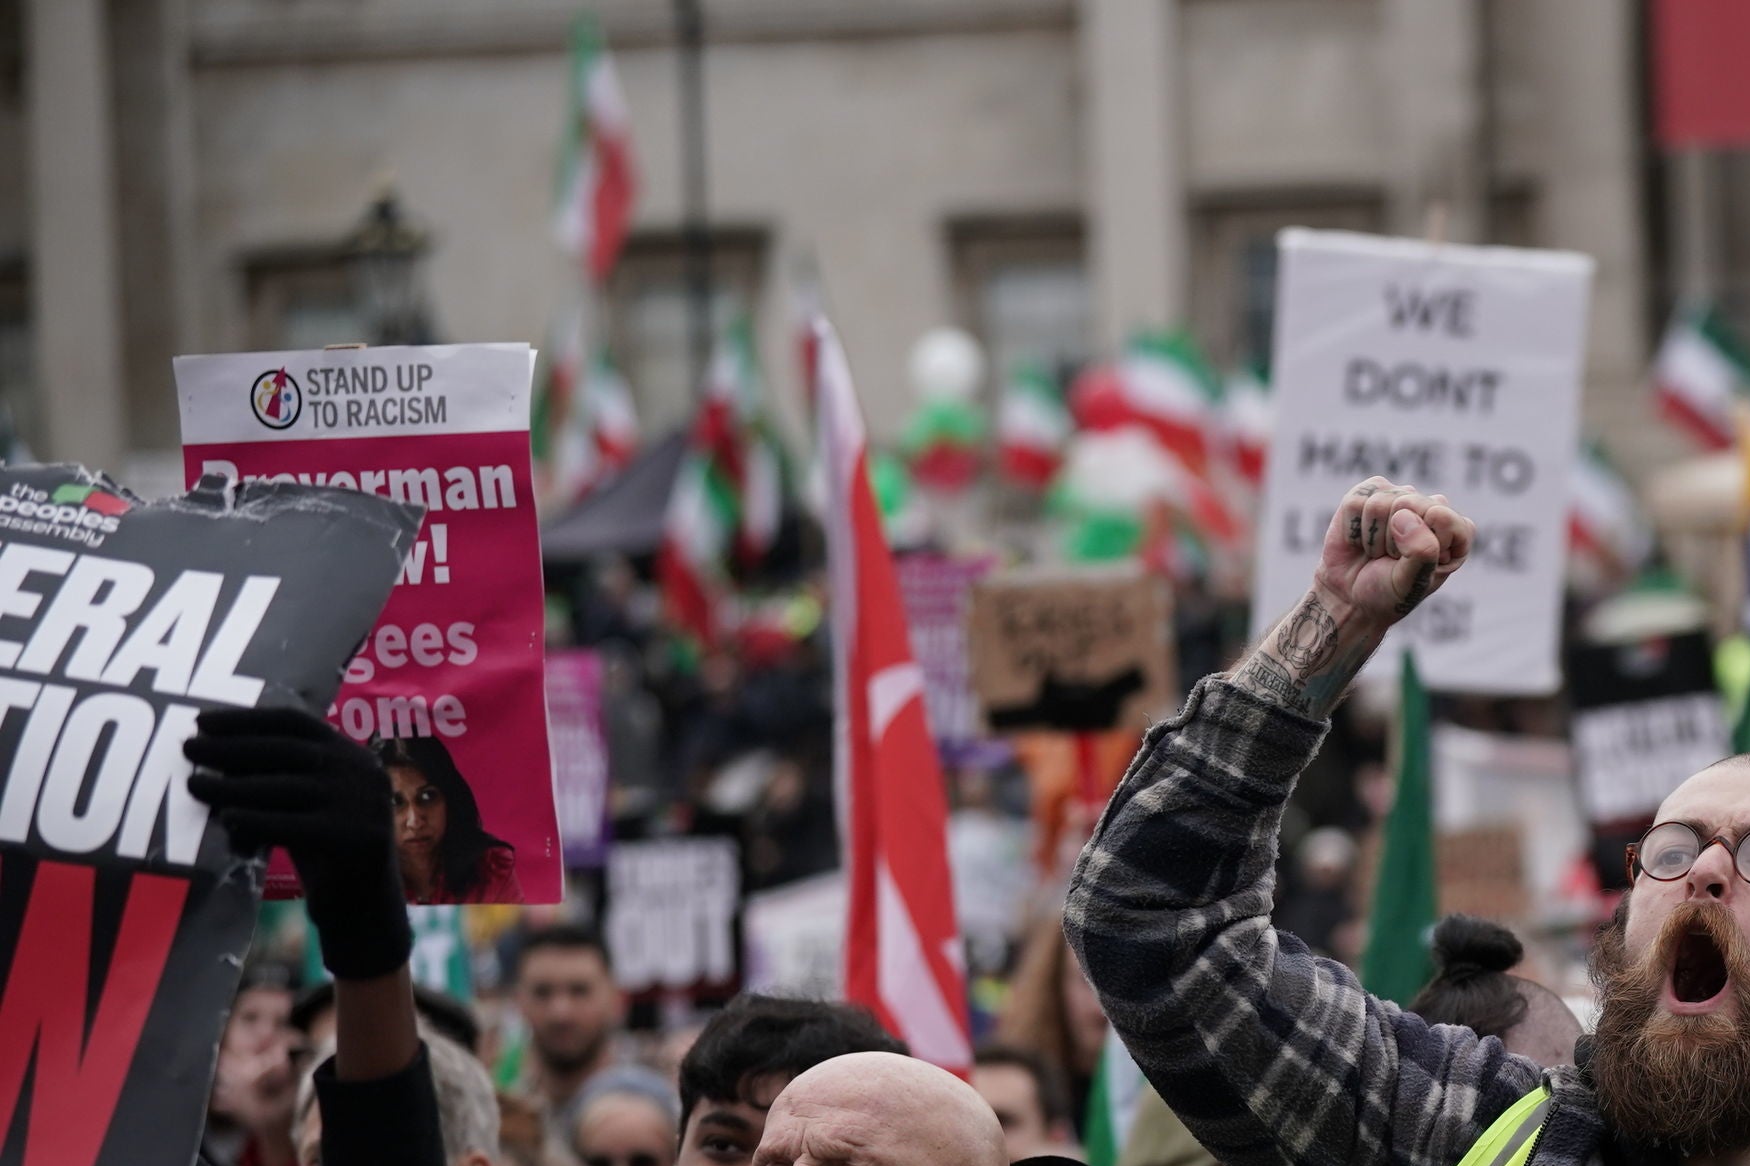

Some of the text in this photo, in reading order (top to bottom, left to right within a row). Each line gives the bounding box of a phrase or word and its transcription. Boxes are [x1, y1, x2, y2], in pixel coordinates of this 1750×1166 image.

[1383, 284, 1478, 338] WE
[307, 363, 433, 396] STAND UP
[1346, 357, 1506, 414] DONT
[308, 395, 447, 429] TO RACISM
[1299, 432, 1536, 496] HAVE TO
[10, 482, 48, 502] the
[343, 621, 478, 684] gees
